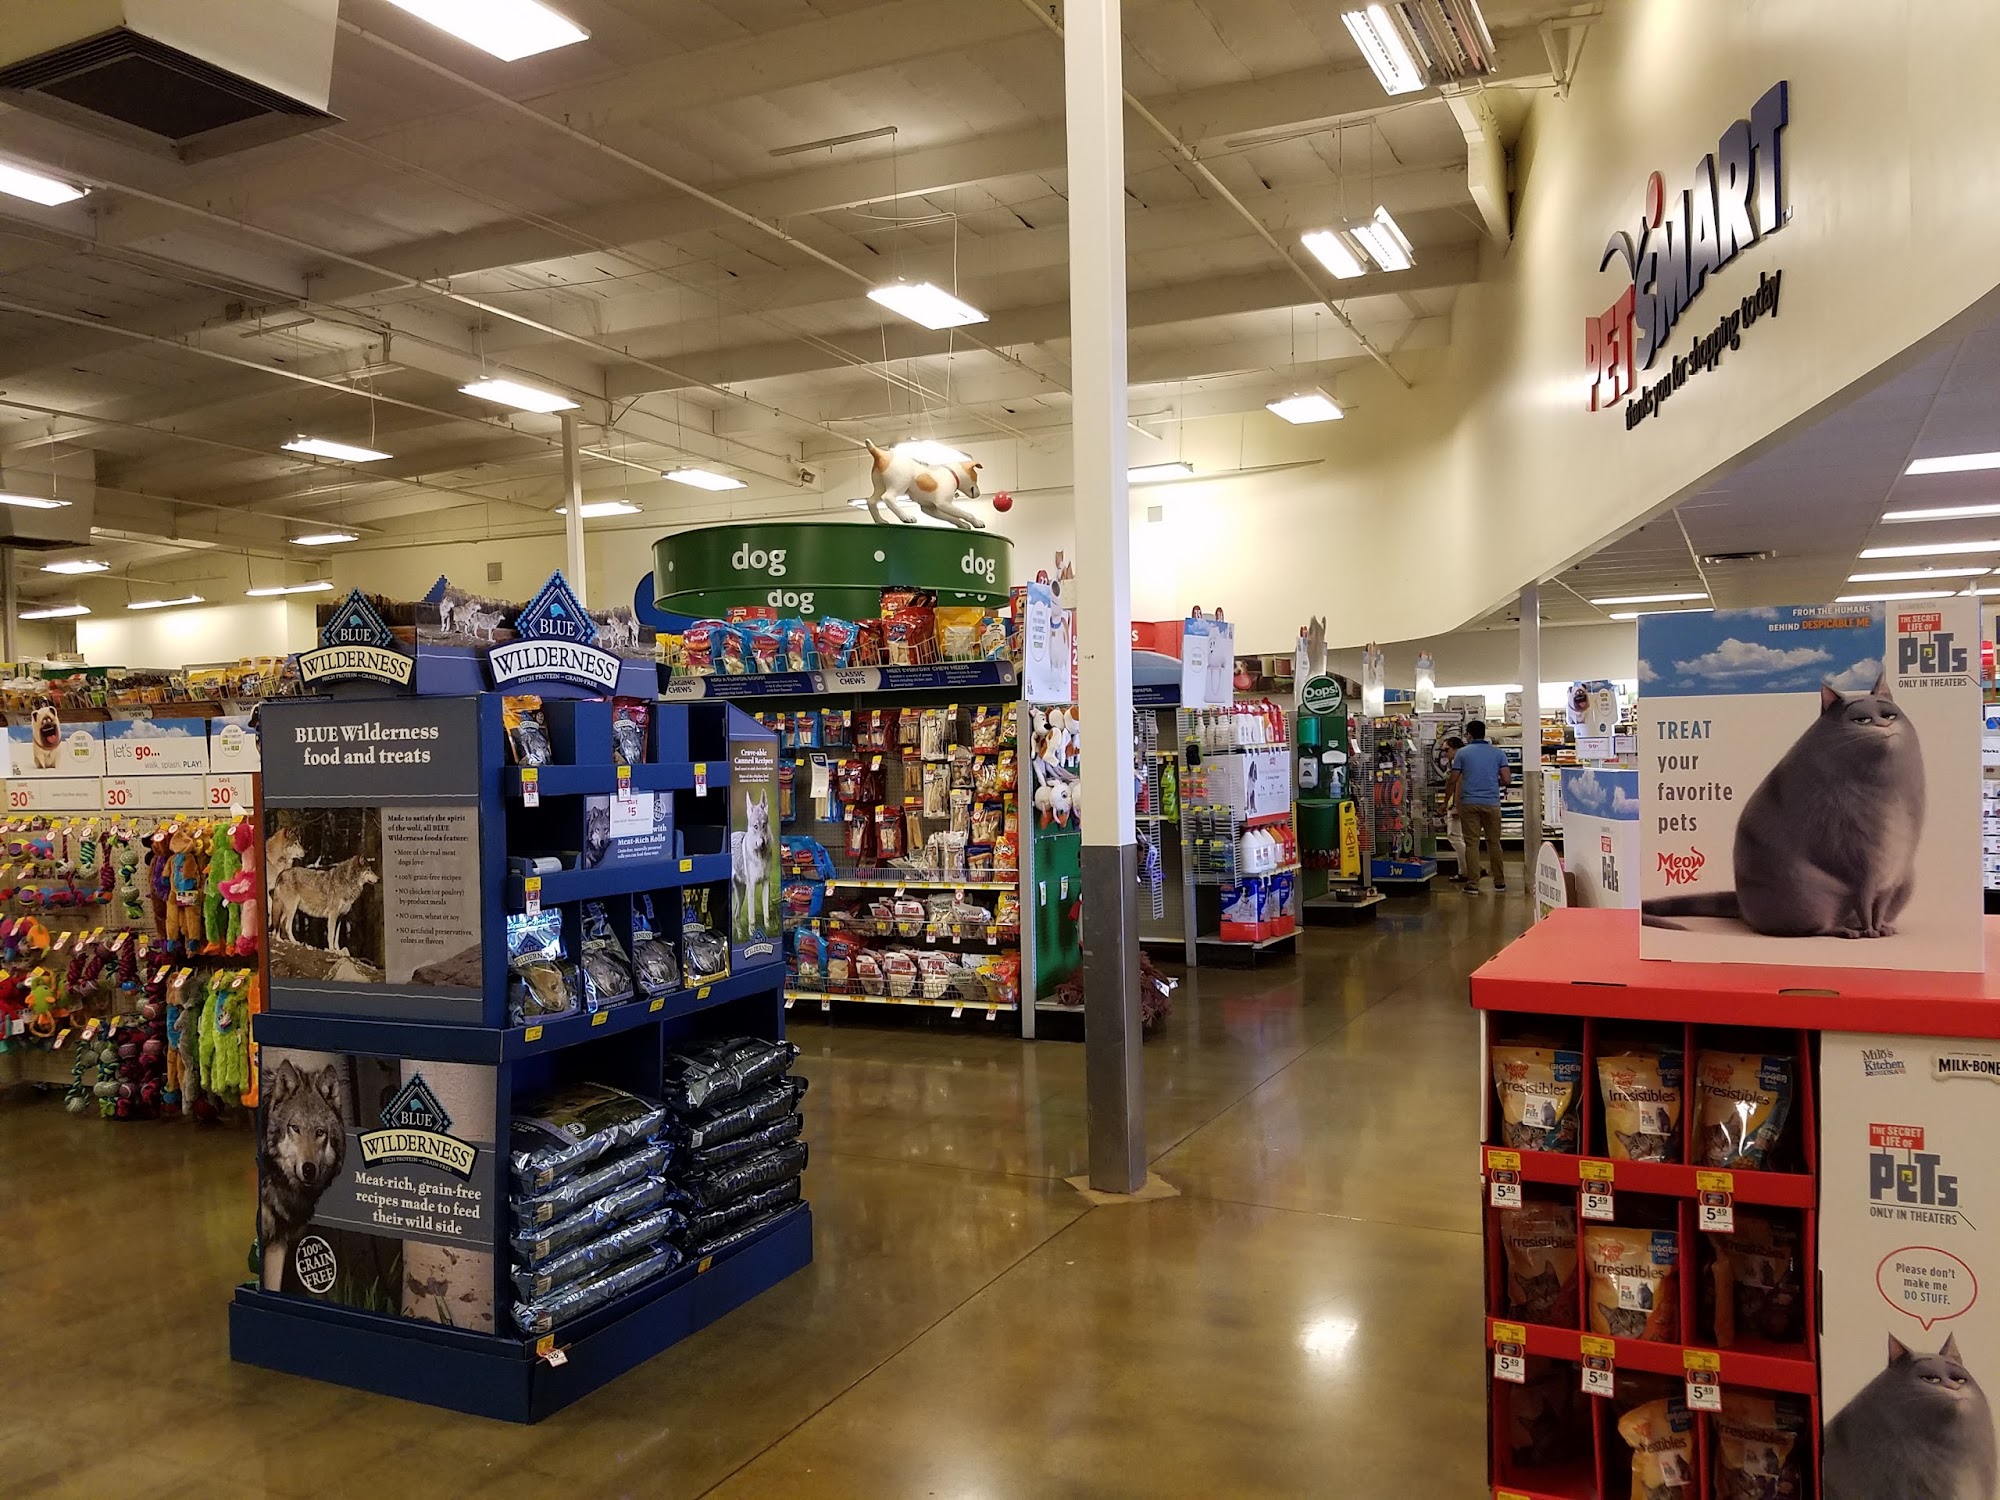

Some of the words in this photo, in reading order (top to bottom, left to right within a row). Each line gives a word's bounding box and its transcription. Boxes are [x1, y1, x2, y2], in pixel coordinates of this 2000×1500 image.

[1625, 386, 1653, 431] thanks
[1653, 373, 1671, 417] you
[1672, 355, 1688, 390] for
[1689, 309, 1740, 375] shopping
[1741, 270, 1782, 329] today
[732, 543, 786, 576] dog
[961, 548, 996, 584] dog
[767, 588, 814, 614] dog
[1792, 608, 1816, 616] FROM
[1817, 607, 1832, 615] THE
[1834, 606, 1870, 614] HUMANS
[1912, 614, 1940, 622] SECRET
[540, 618, 576, 636] BLUE
[1768, 623, 1800, 632] BEHIND
[1802, 618, 1854, 630] DESPICABLE
[1856, 616, 1870, 628] ME
[1907, 622, 1923, 631] LIFE
[340, 628, 372, 642] BLUE
[302, 650, 408, 678] WILDERNESS
[494, 646, 615, 681] WILDERNESS
[518, 675, 534, 684] HIGH
[1898, 679, 1918, 688] ONLY
[1920, 678, 1928, 688] IN
[1930, 678, 1967, 687] THEATERS
[1305, 682, 1338, 698] Oops!
[295, 726, 338, 744] BLUE
[340, 722, 439, 742] Wilderness
[1657, 720, 1712, 740] TREAT
[112, 744, 132, 758] let's
[304, 749, 340, 766] food
[344, 747, 376, 764] and
[378, 747, 431, 764] treats
[183, 760, 202, 768] PLAY!
[755, 757, 774, 766] Recipes
[1658, 754, 1699, 770] your
[1658, 782, 1733, 802] favorite
[413, 814, 434, 824] satisfy
[448, 814, 466, 824] spirit
[1658, 813, 1697, 834] pets
[618, 836, 650, 846] Meat-Rich
[650, 834, 666, 842] Rolls
[398, 859, 411, 867] dogs
[1657, 846, 1705, 872] Meow
[1861, 1048, 1894, 1060] Milo's
[1550, 1063, 1582, 1072] BIGGER
[1864, 1060, 1904, 1071] Kitchen
[1938, 1058, 2000, 1076] MILK-BONE
[1502, 1079, 1566, 1096] Irresistibles
[1700, 1082, 1770, 1105] Irresistibles
[1609, 1090, 1676, 1102] Irresistibles
[401, 1111, 433, 1127] BLUE
[1872, 1126, 1886, 1135] THE
[1887, 1126, 1922, 1138] SECRET
[1881, 1136, 1901, 1147] LIFE
[1902, 1139, 1913, 1148] OF
[364, 1134, 470, 1168] WILDERNESS
[355, 1171, 416, 1193] Meat-rich,
[418, 1182, 482, 1200] grain-free
[356, 1192, 399, 1208] recipes
[401, 1198, 435, 1212] made
[437, 1202, 450, 1214] to
[453, 1202, 480, 1218] feed
[373, 1209, 403, 1225] their
[405, 1215, 433, 1231] wild
[436, 1220, 462, 1234] side
[1870, 1206, 1893, 1218] ONLY
[1896, 1210, 1907, 1220] IN
[1910, 1210, 1958, 1225] THEATERS
[1509, 1235, 1576, 1248] Irresistibles
[1648, 1245, 1678, 1254] BIGGER
[302, 1243, 322, 1258] 100%
[299, 1252, 334, 1273] GRAIN
[1594, 1261, 1665, 1279] Irresistibles
[304, 1268, 333, 1286] FREE
[1896, 1263, 1927, 1277] Please
[1930, 1266, 1956, 1279] don't
[1904, 1277, 1930, 1289] make
[1933, 1281, 1948, 1291] me
[1904, 1290, 1917, 1301] DO
[1920, 1291, 1950, 1305] STUFF.
